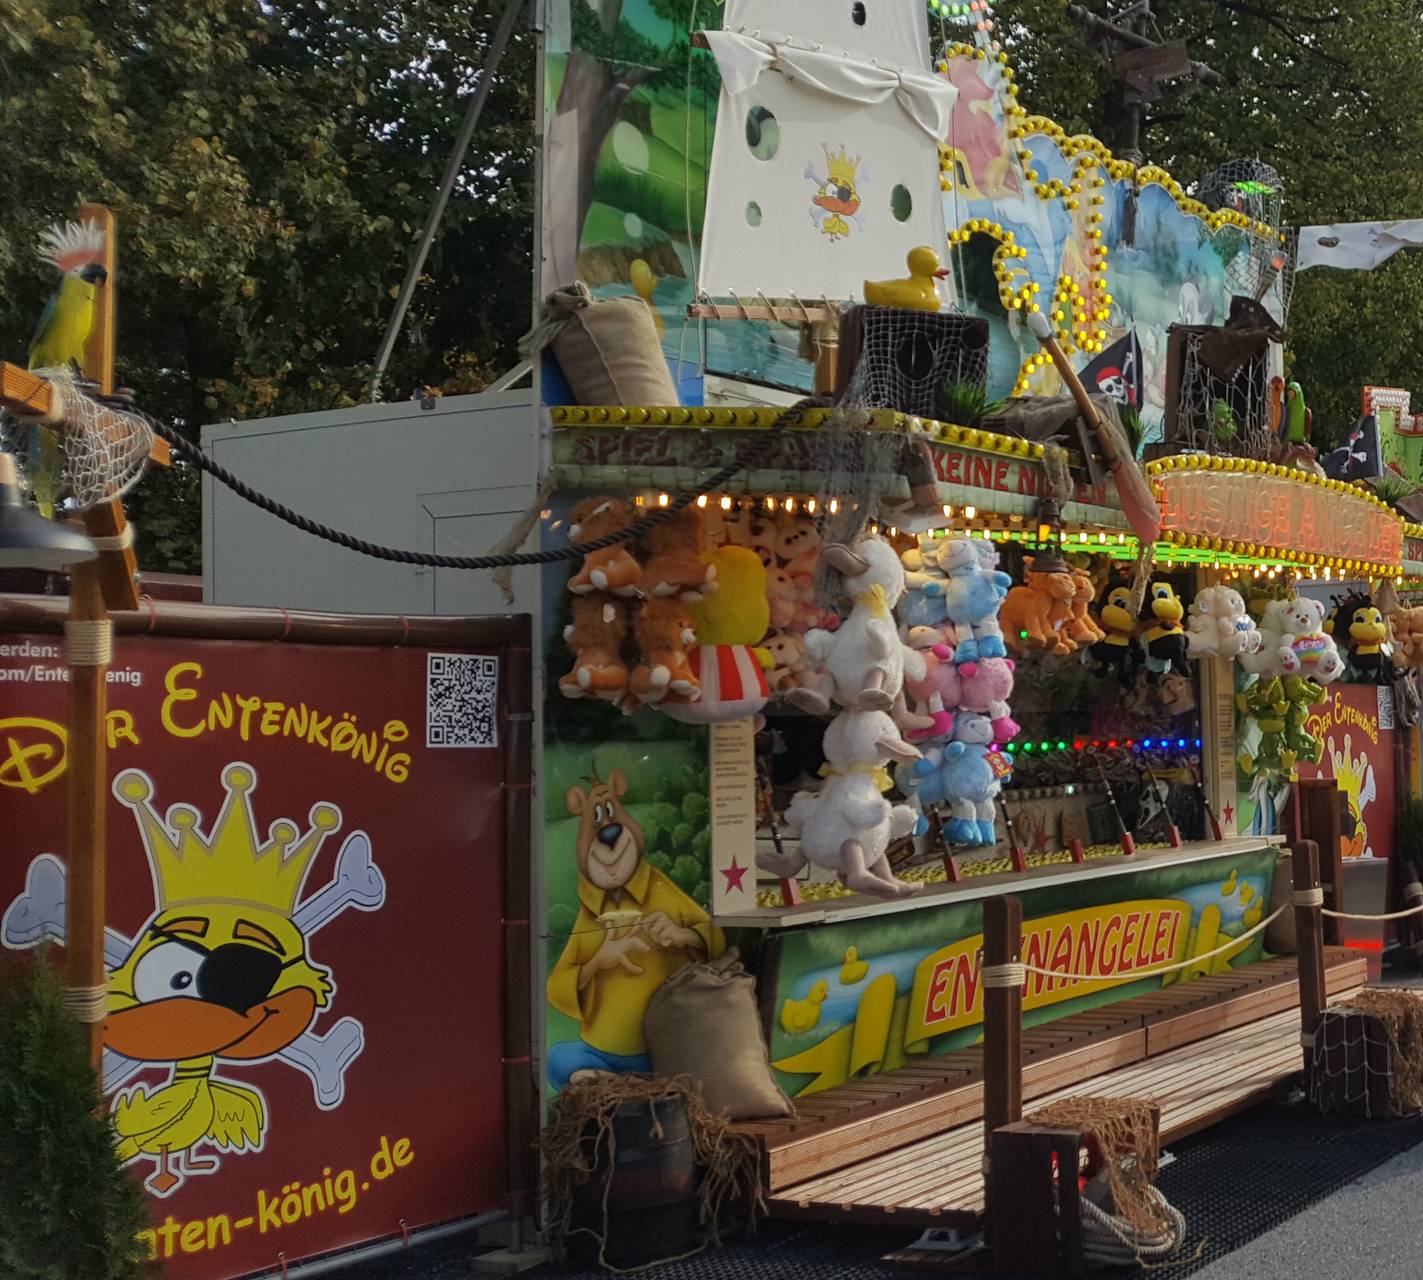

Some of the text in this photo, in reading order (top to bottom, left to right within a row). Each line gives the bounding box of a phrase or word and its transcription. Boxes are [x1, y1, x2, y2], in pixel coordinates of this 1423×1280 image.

[931, 447, 1009, 492] KEINE
[1017, 463, 1106, 505] NIEN
[0, 665, 142, 687] om/Enteenig
[0, 709, 140, 794] DR
[924, 910, 1182, 1026] ENNANGELEI
